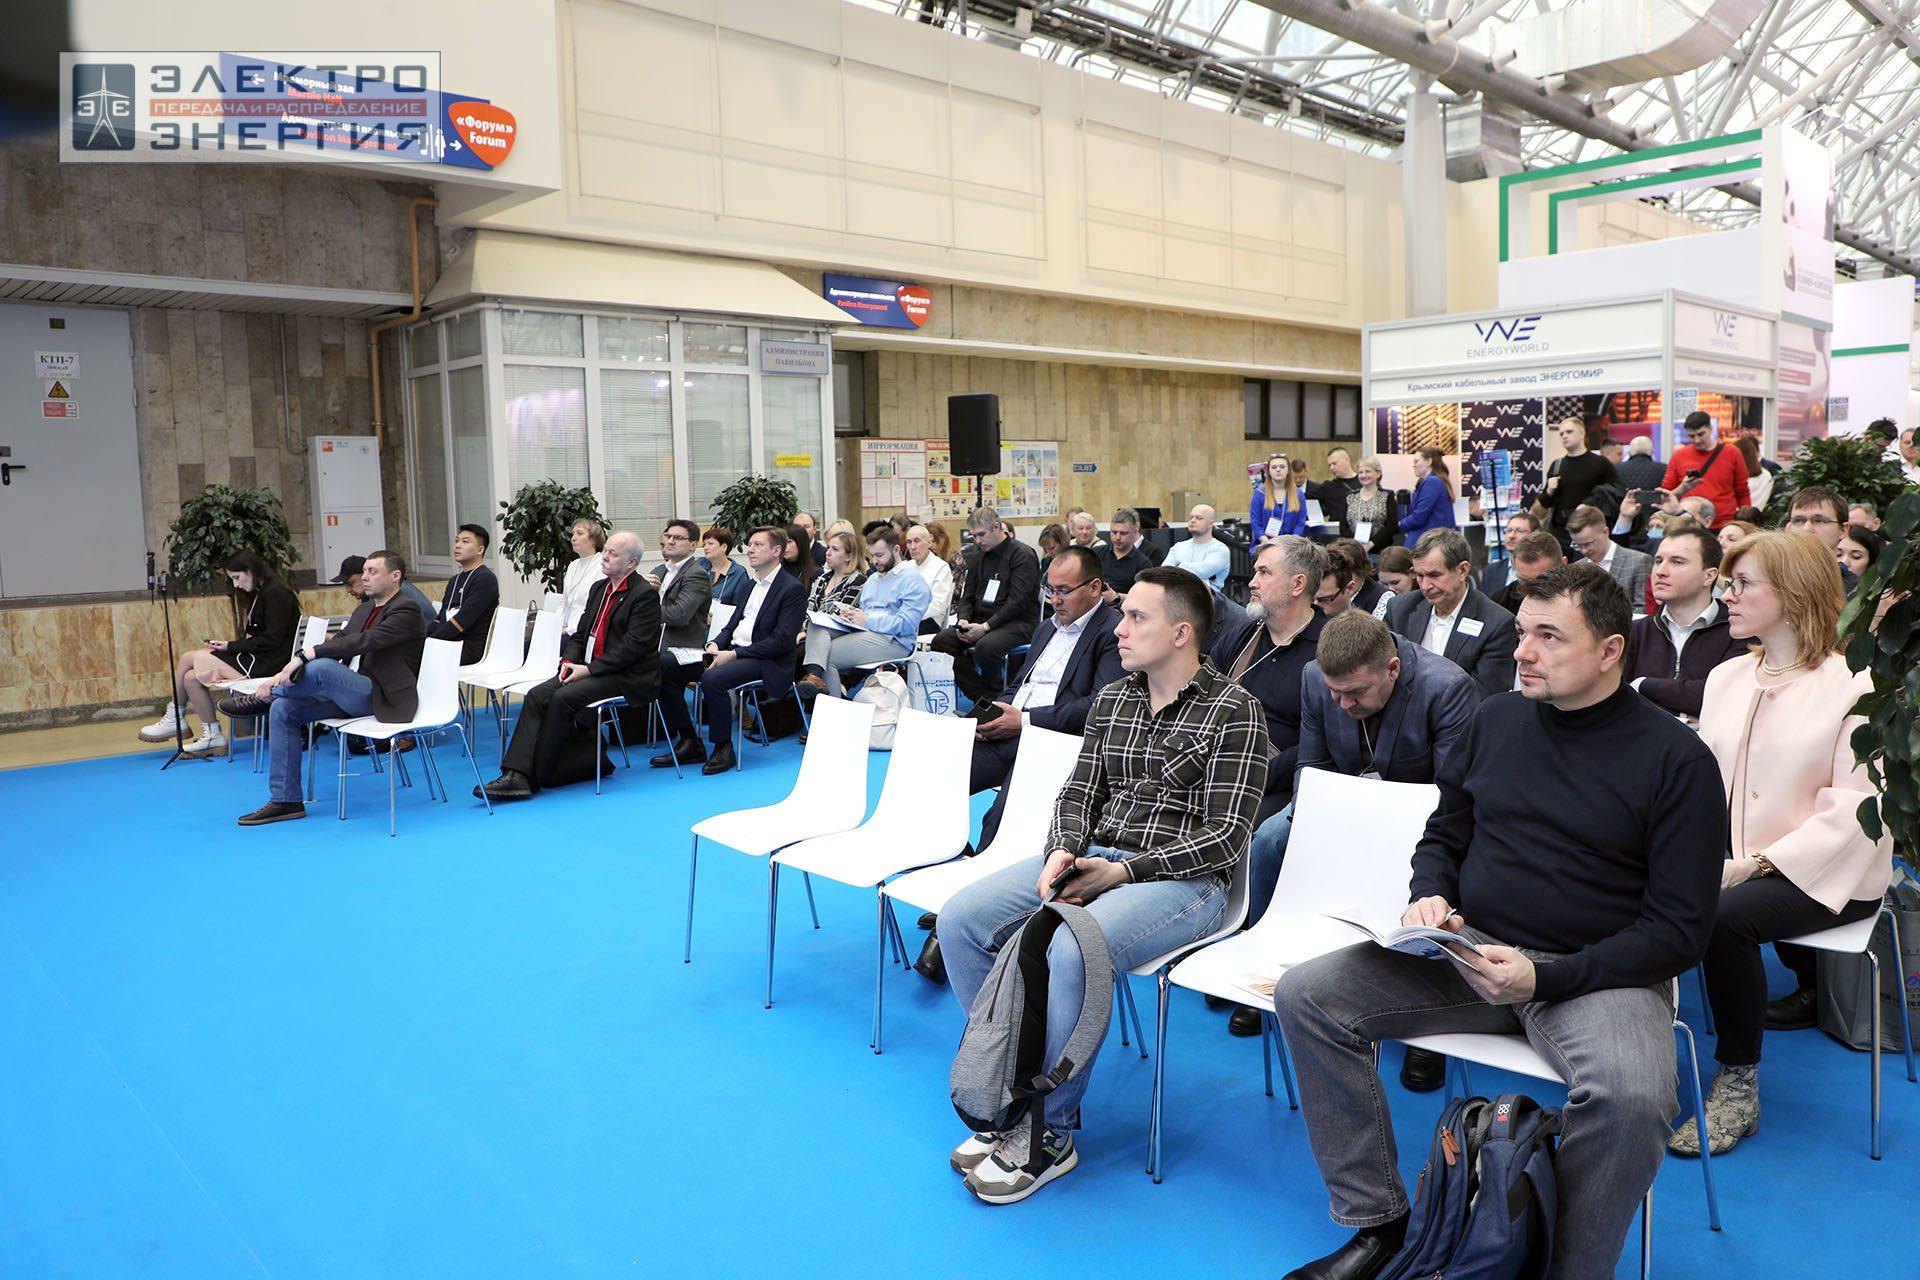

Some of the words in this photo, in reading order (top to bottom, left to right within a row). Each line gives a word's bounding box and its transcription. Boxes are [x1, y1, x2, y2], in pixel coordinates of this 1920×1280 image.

[456, 114, 514, 134] «Форум»
[469, 131, 507, 149] Forum
[906, 304, 927, 315] Forum
[1466, 342, 1550, 359] ENERGYWORLD
[40, 355, 74, 364] КТП-7
[1407, 380, 1453, 392] Крымский
[1454, 376, 1507, 388] кабельный
[1509, 373, 1538, 385] завод
[1540, 368, 1604, 382] ЭНЕРГОМИР
[867, 442, 919, 450] ИНФОРМАЦИЯ
